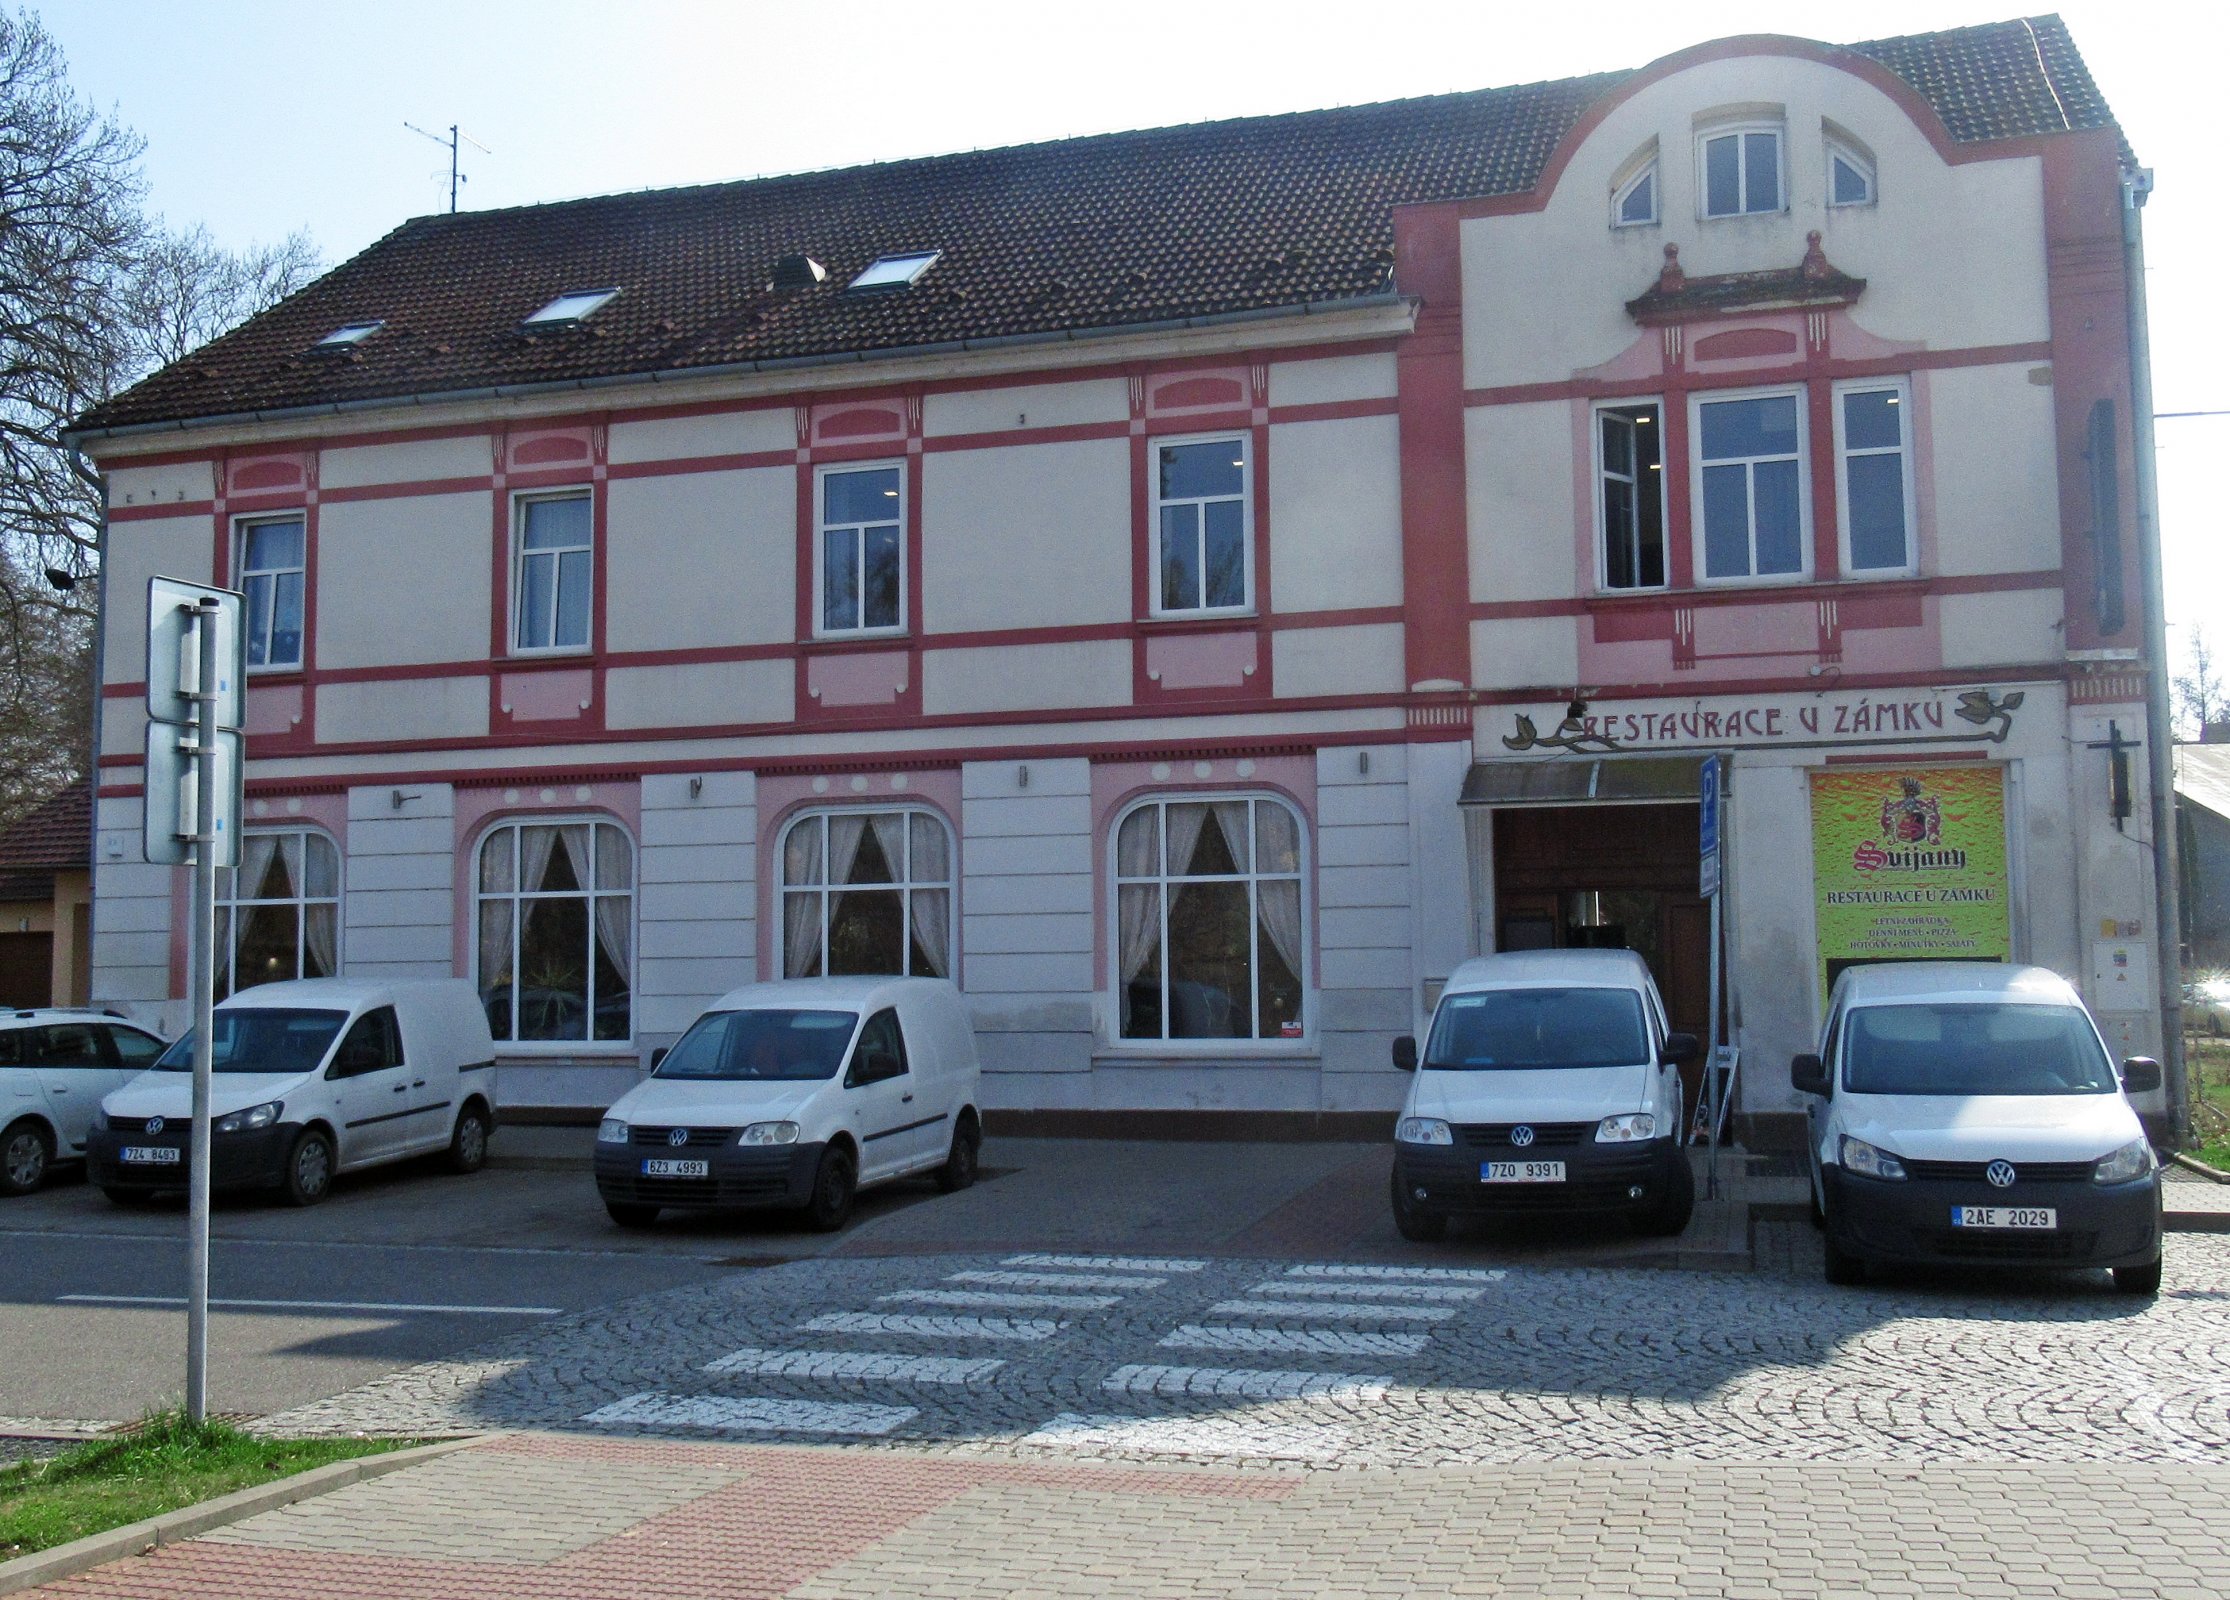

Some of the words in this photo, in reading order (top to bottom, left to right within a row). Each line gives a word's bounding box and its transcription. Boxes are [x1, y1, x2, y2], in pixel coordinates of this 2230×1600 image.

[1799, 706, 1818, 734] U
[1833, 697, 1943, 734] ZÁMKU
[1703, 770, 1713, 824] P
[1853, 840, 1967, 872] Svijany
[1827, 890, 1922, 904] RESTAURACE
[1926, 890, 1936, 902] U
[1931, 928, 1956, 936] PIZZA
[650, 1161, 669, 1173] 6Z3
[676, 1161, 703, 1174] 4993
[1526, 1163, 1559, 1177] 9391
[1965, 1209, 1996, 1225] 2AE
[2008, 1210, 2049, 1226] 2029
